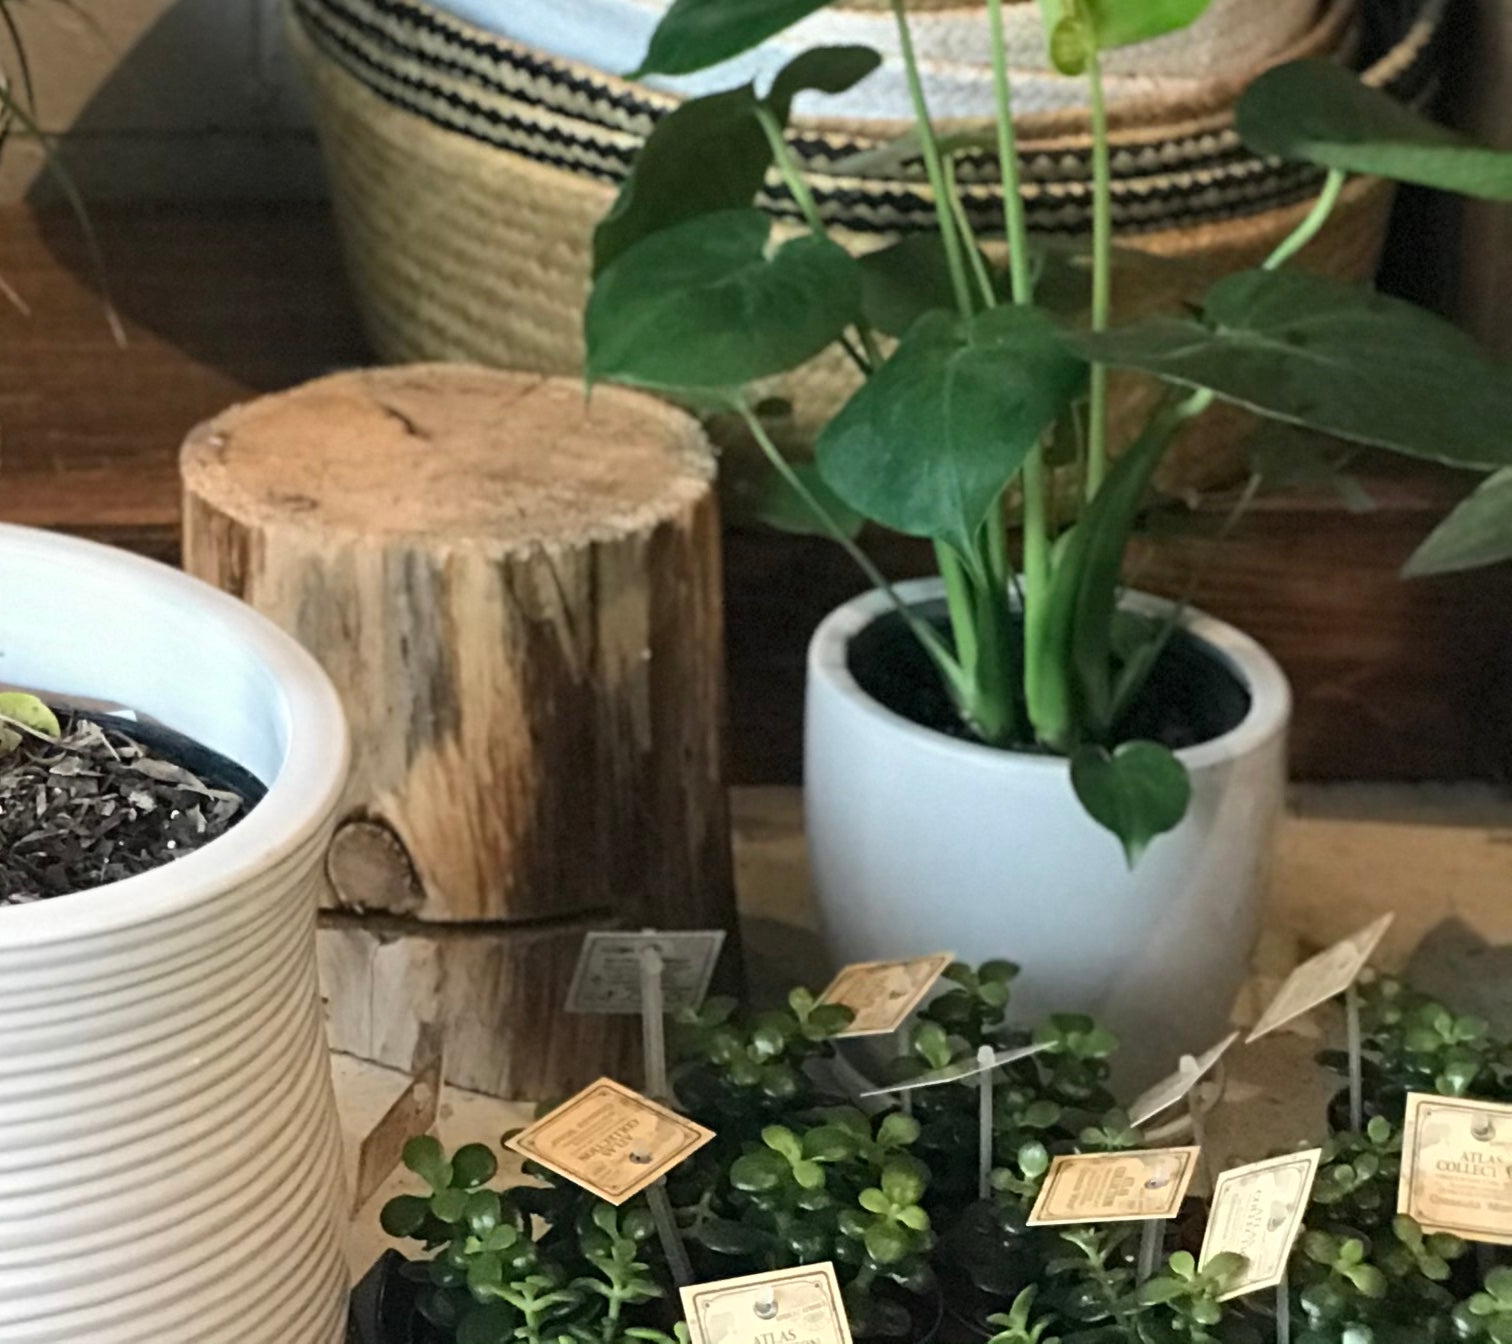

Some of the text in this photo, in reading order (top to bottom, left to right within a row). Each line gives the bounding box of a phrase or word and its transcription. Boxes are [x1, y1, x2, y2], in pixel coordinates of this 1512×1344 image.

[1461, 1151, 1504, 1165] ATLAS
[1435, 1159, 1512, 1180] COLLECT
[754, 1329, 798, 1344] ATLAS
